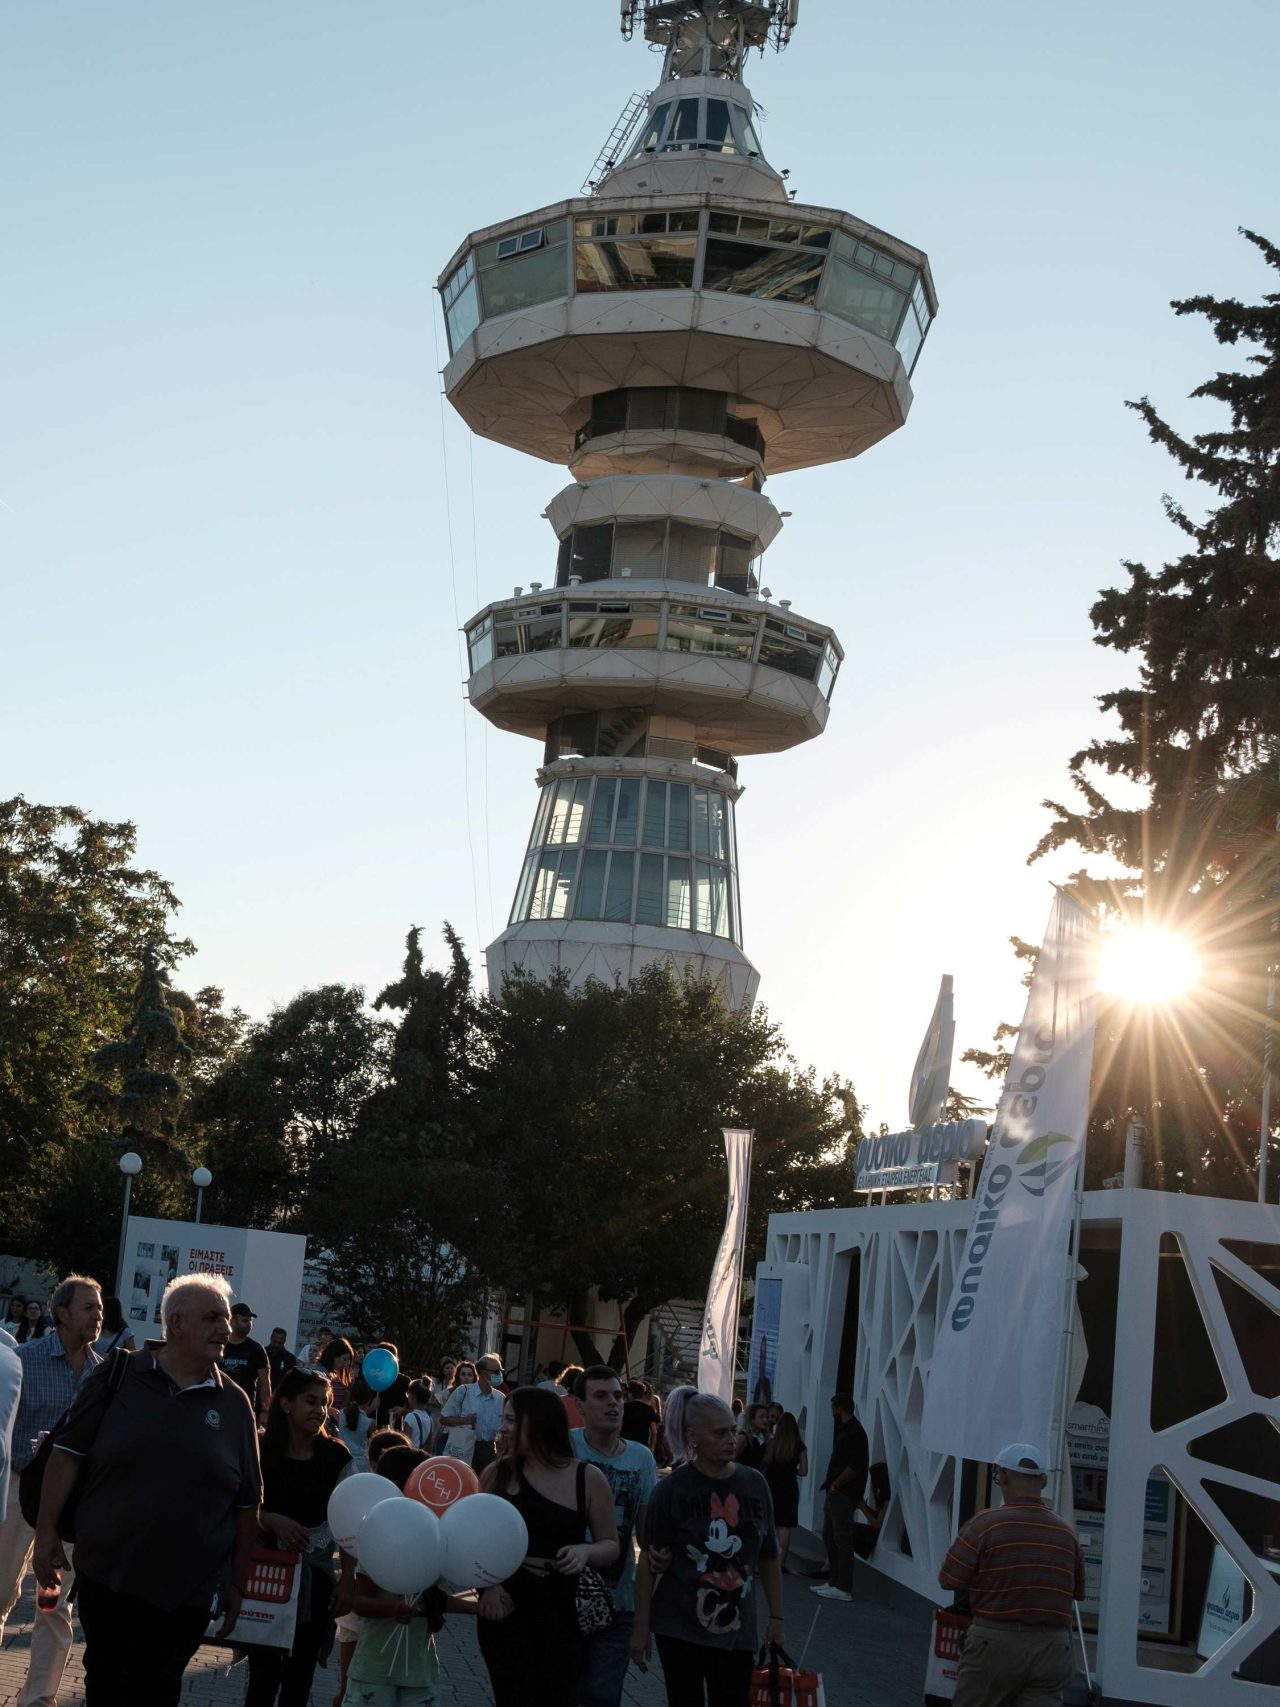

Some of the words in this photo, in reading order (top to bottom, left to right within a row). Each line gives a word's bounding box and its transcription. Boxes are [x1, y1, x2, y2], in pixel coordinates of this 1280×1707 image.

[189, 1248, 225, 1262] ΕΙΜΑΣΤΕ
[188, 1260, 197, 1271] ΟΙ
[199, 1261, 234, 1276] ΠΡΑΞΕΙΣ
[426, 1470, 451, 1500] ΔΕΗ
